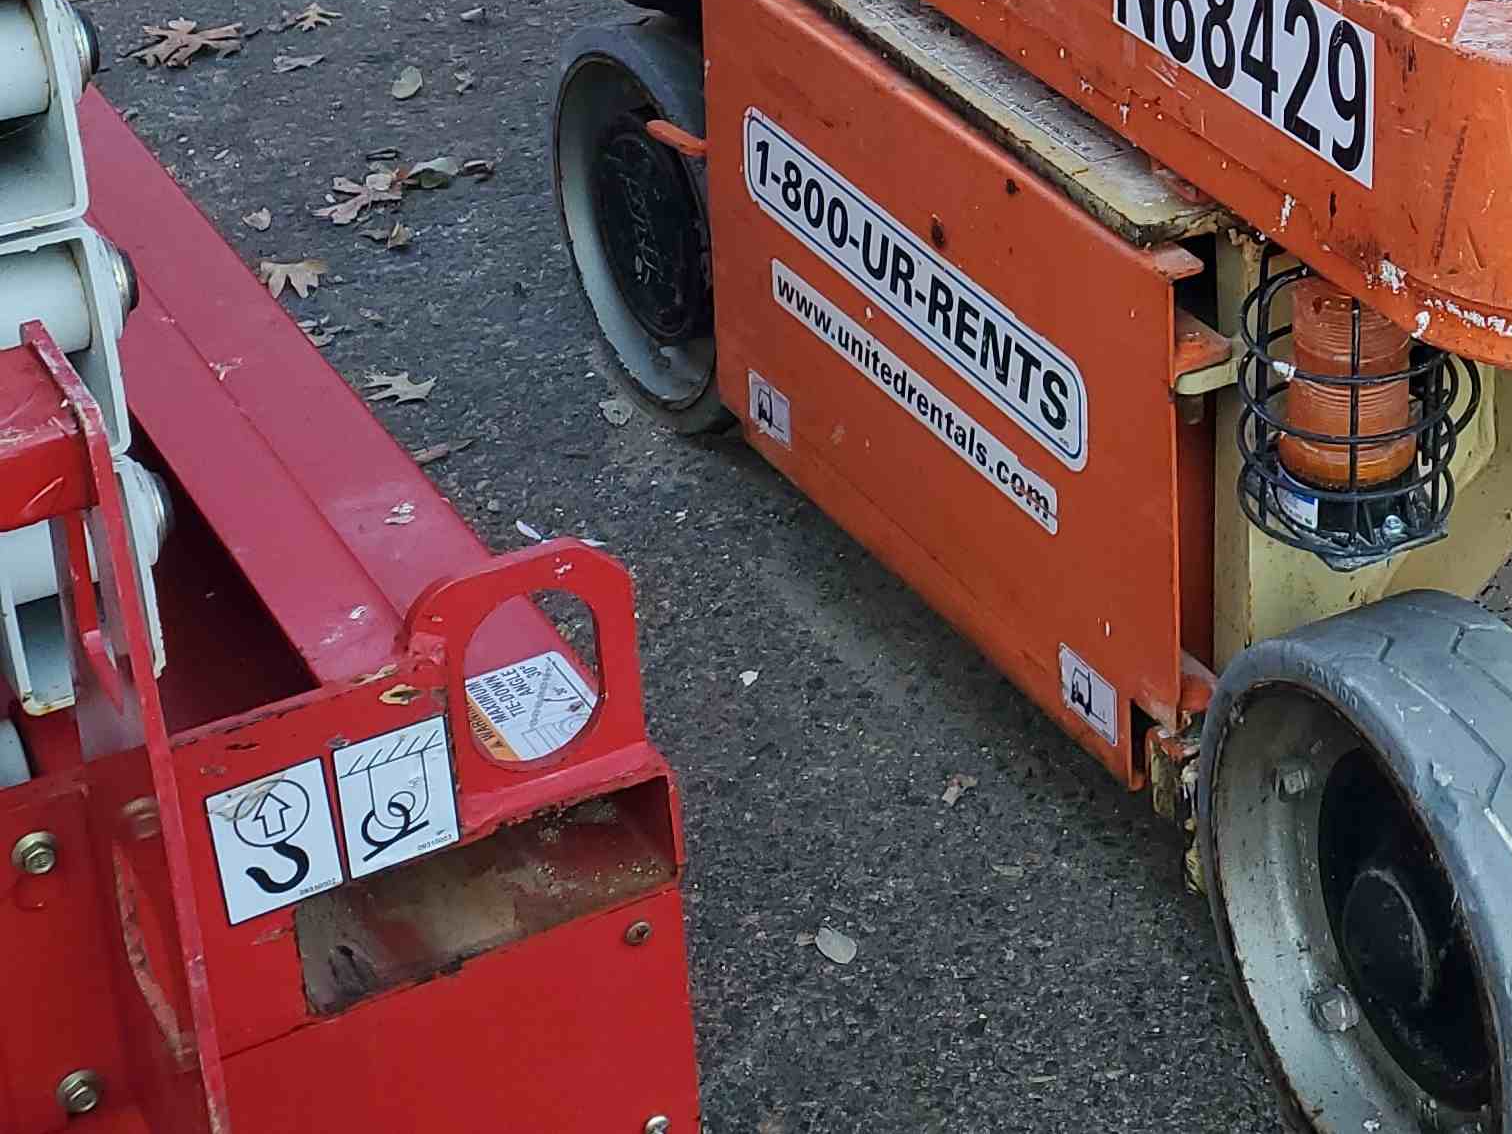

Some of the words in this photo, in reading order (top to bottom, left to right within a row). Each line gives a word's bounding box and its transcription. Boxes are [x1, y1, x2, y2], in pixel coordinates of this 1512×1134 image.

[755, 139, 1068, 431] 1-800-UR-RENTS
[777, 274, 1049, 520] www.unitedrentals.com
[468, 680, 510, 724] MAXIMUM
[482, 674, 527, 718] TIE-DOWN
[501, 668, 535, 697] ANGLE
[468, 705, 495, 741] WARN
